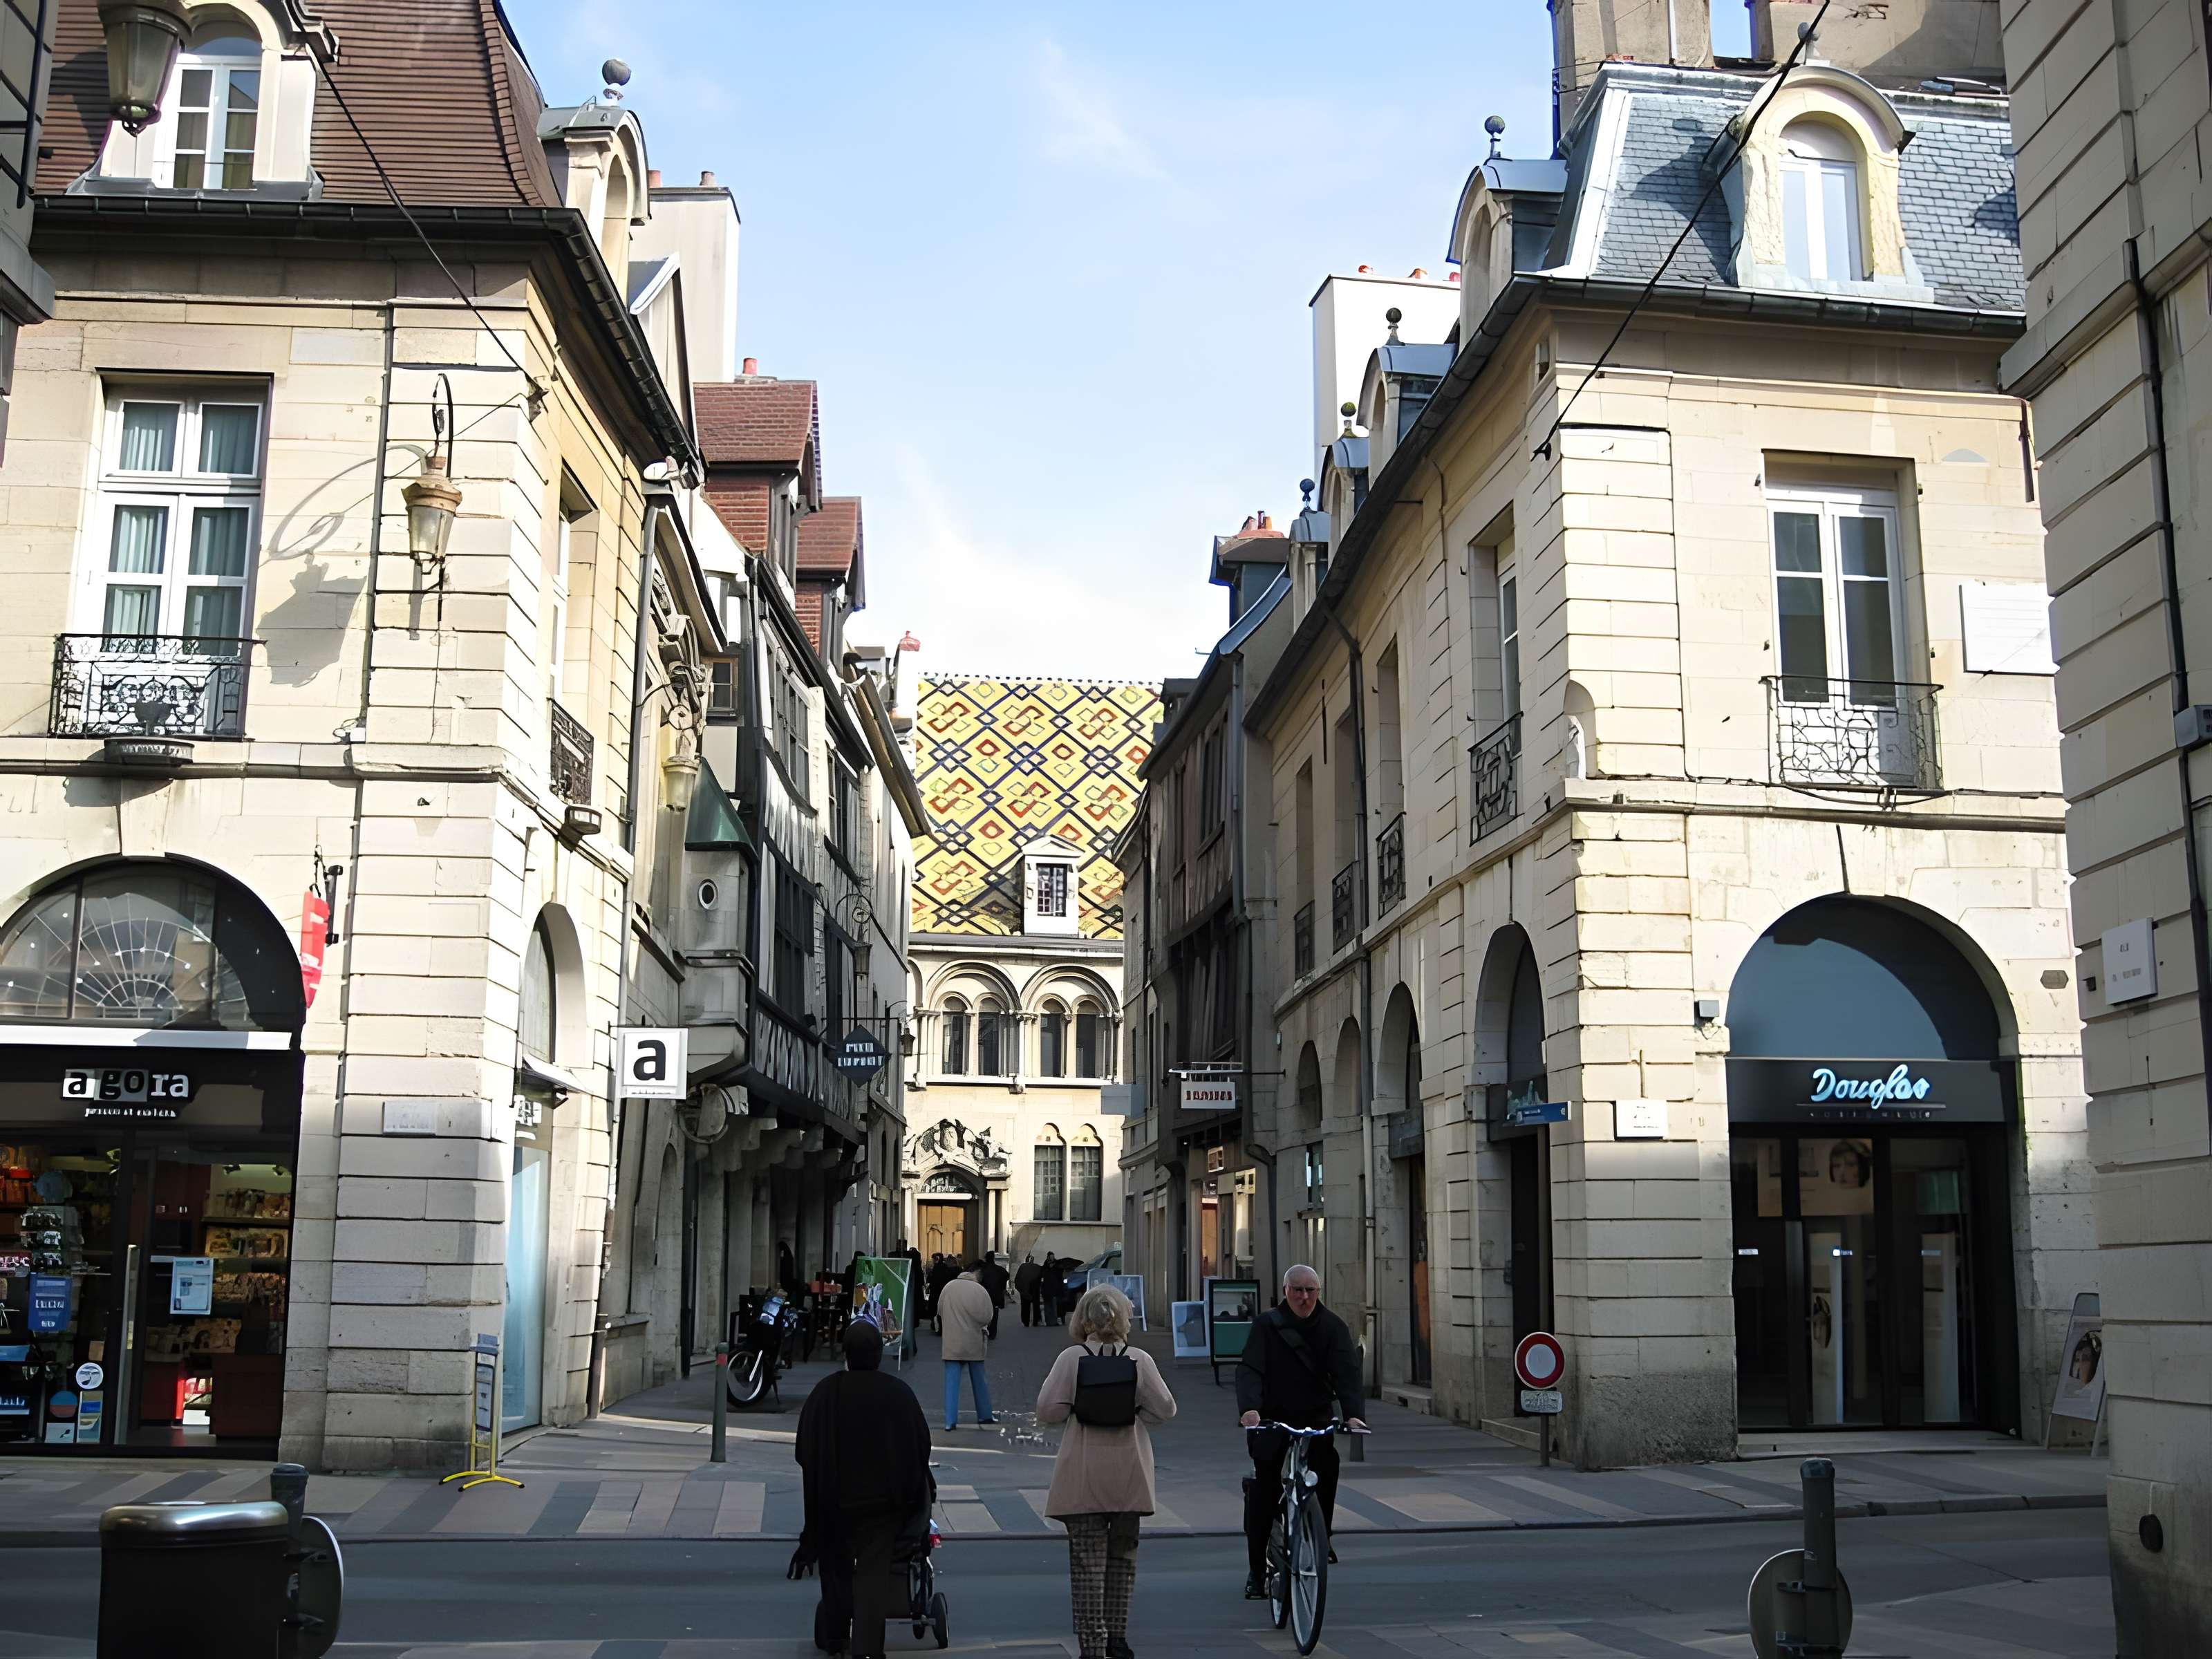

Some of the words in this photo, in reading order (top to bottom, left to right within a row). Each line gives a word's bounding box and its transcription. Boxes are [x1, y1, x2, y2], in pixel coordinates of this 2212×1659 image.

[632, 1039, 666, 1082] a
[66, 1070, 189, 1100] agora
[1810, 1063, 1931, 1110] Douglas
